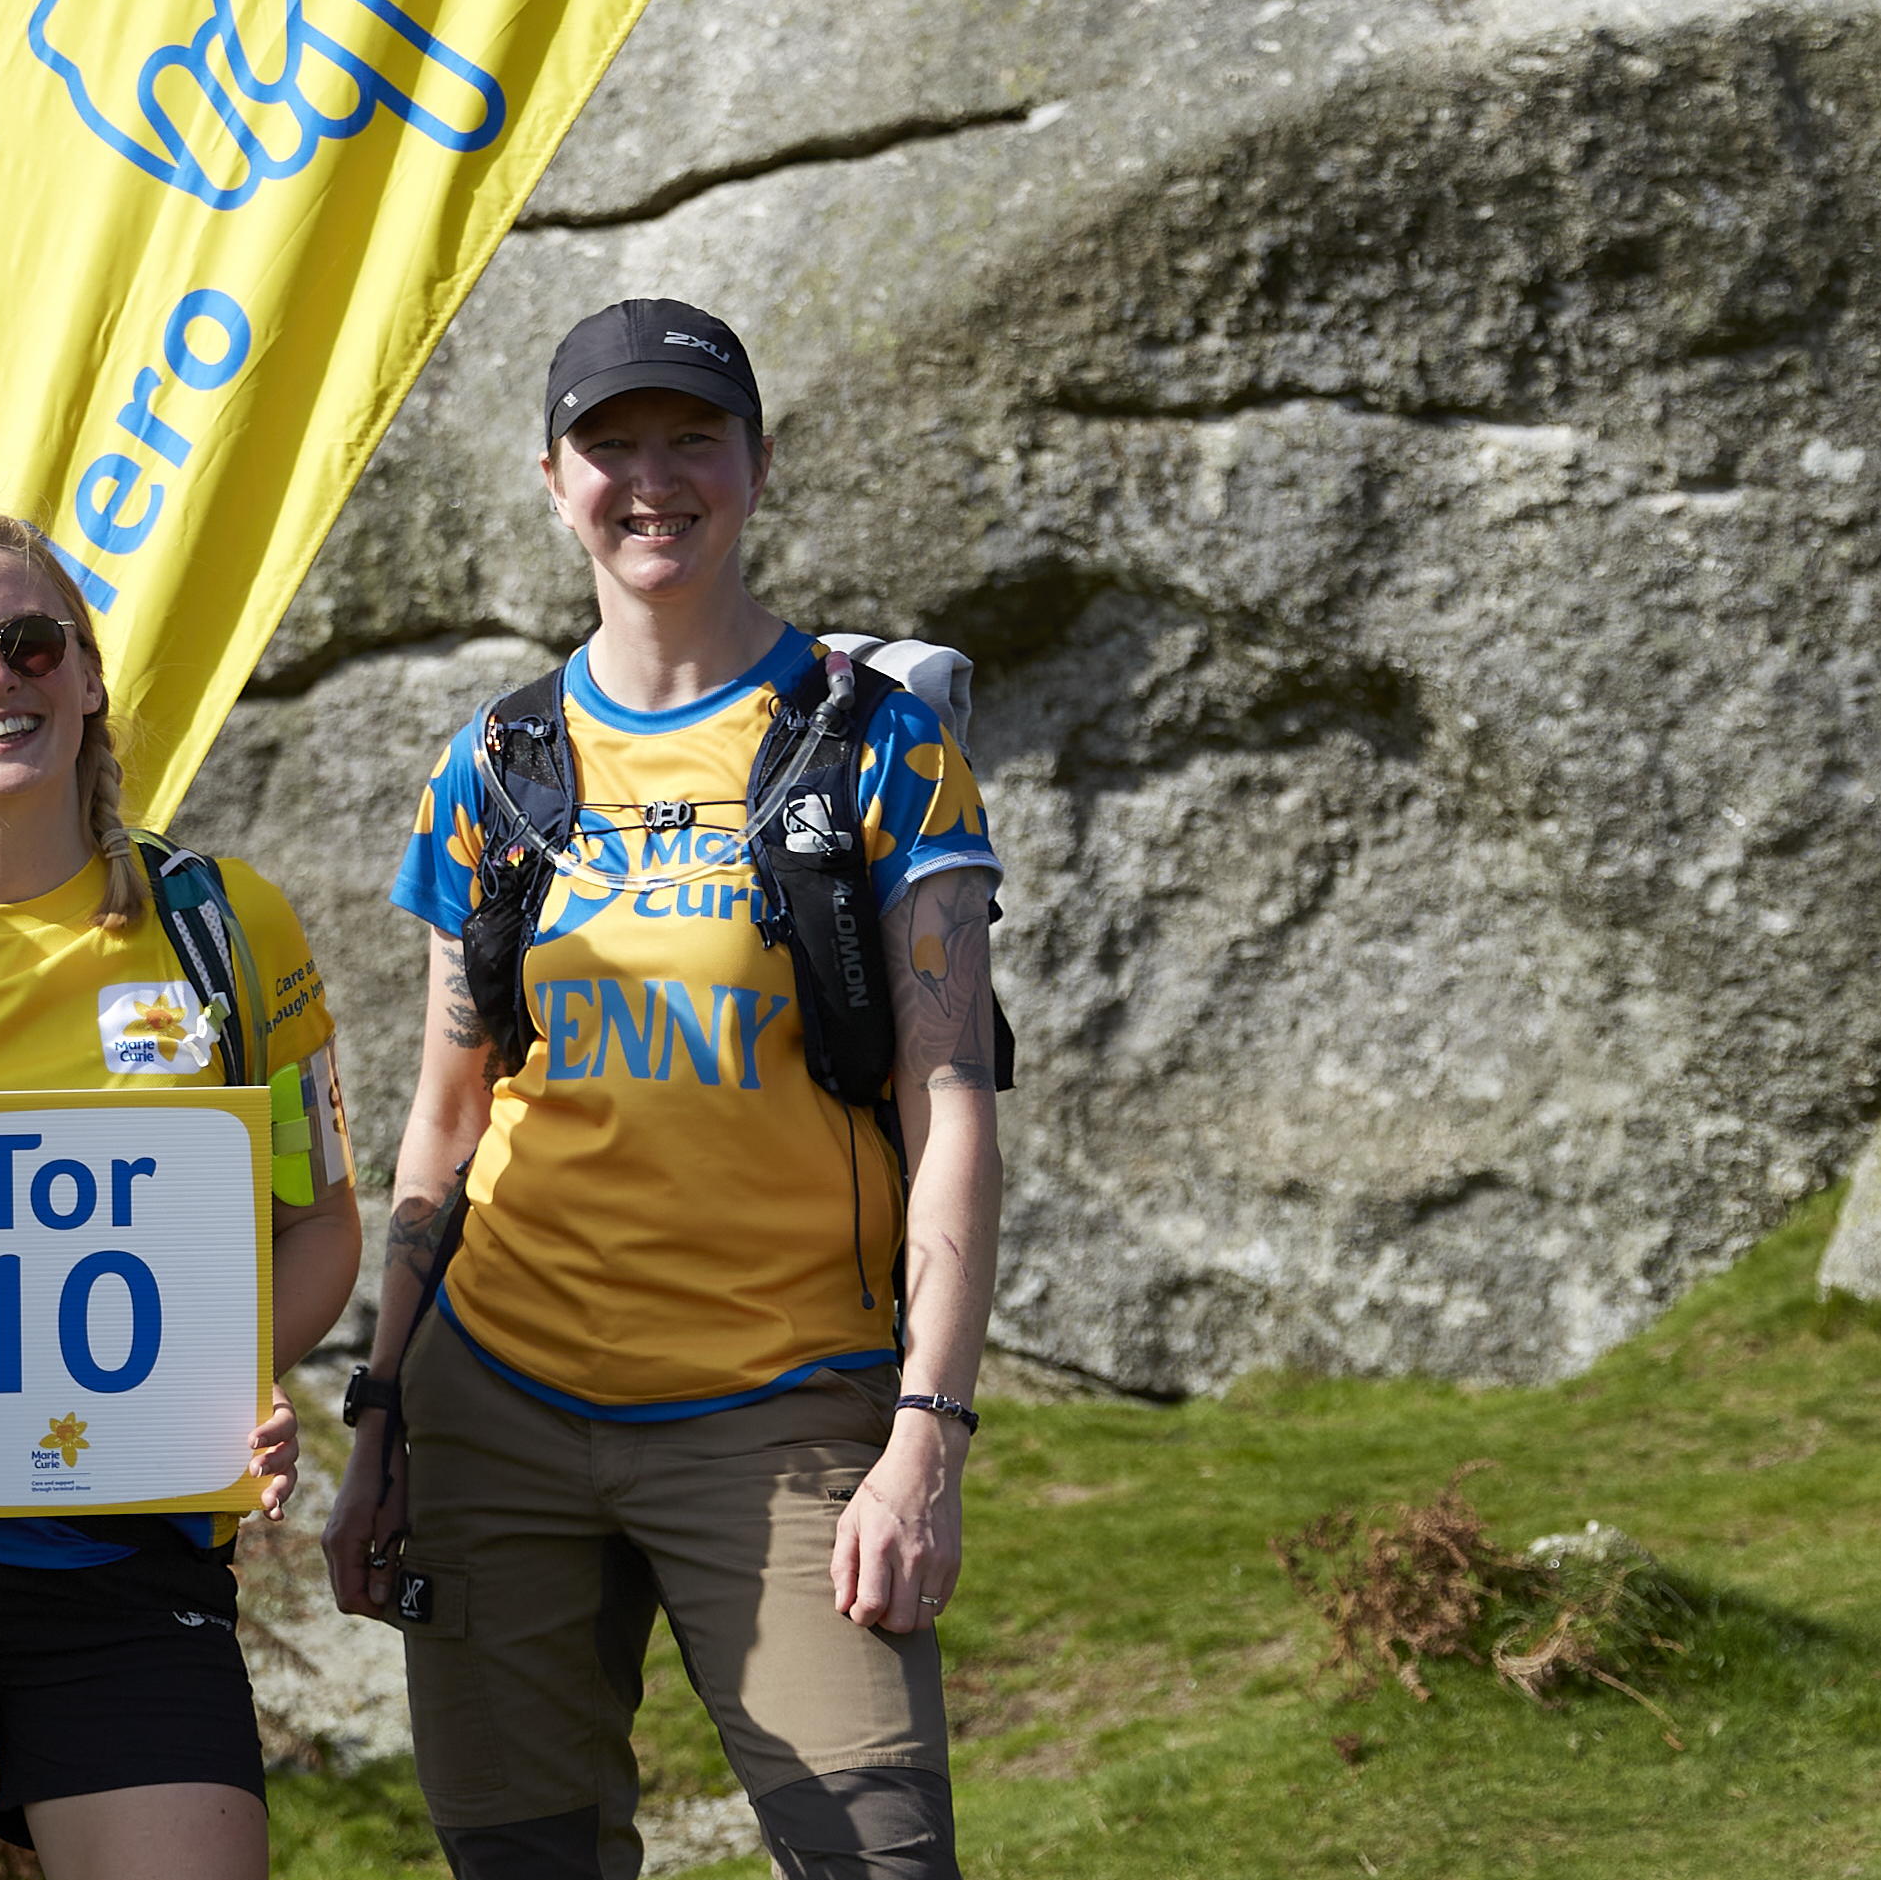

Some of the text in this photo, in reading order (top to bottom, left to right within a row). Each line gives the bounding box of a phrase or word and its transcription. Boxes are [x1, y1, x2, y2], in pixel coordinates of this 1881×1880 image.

[633, 873, 776, 924] Curi
[276, 968, 305, 997] Care
[114, 1039, 155, 1051] Marie
[119, 1050, 155, 1063] Curie
[31, 1450, 60, 1460] Marie
[34, 1459, 60, 1469] Curie
